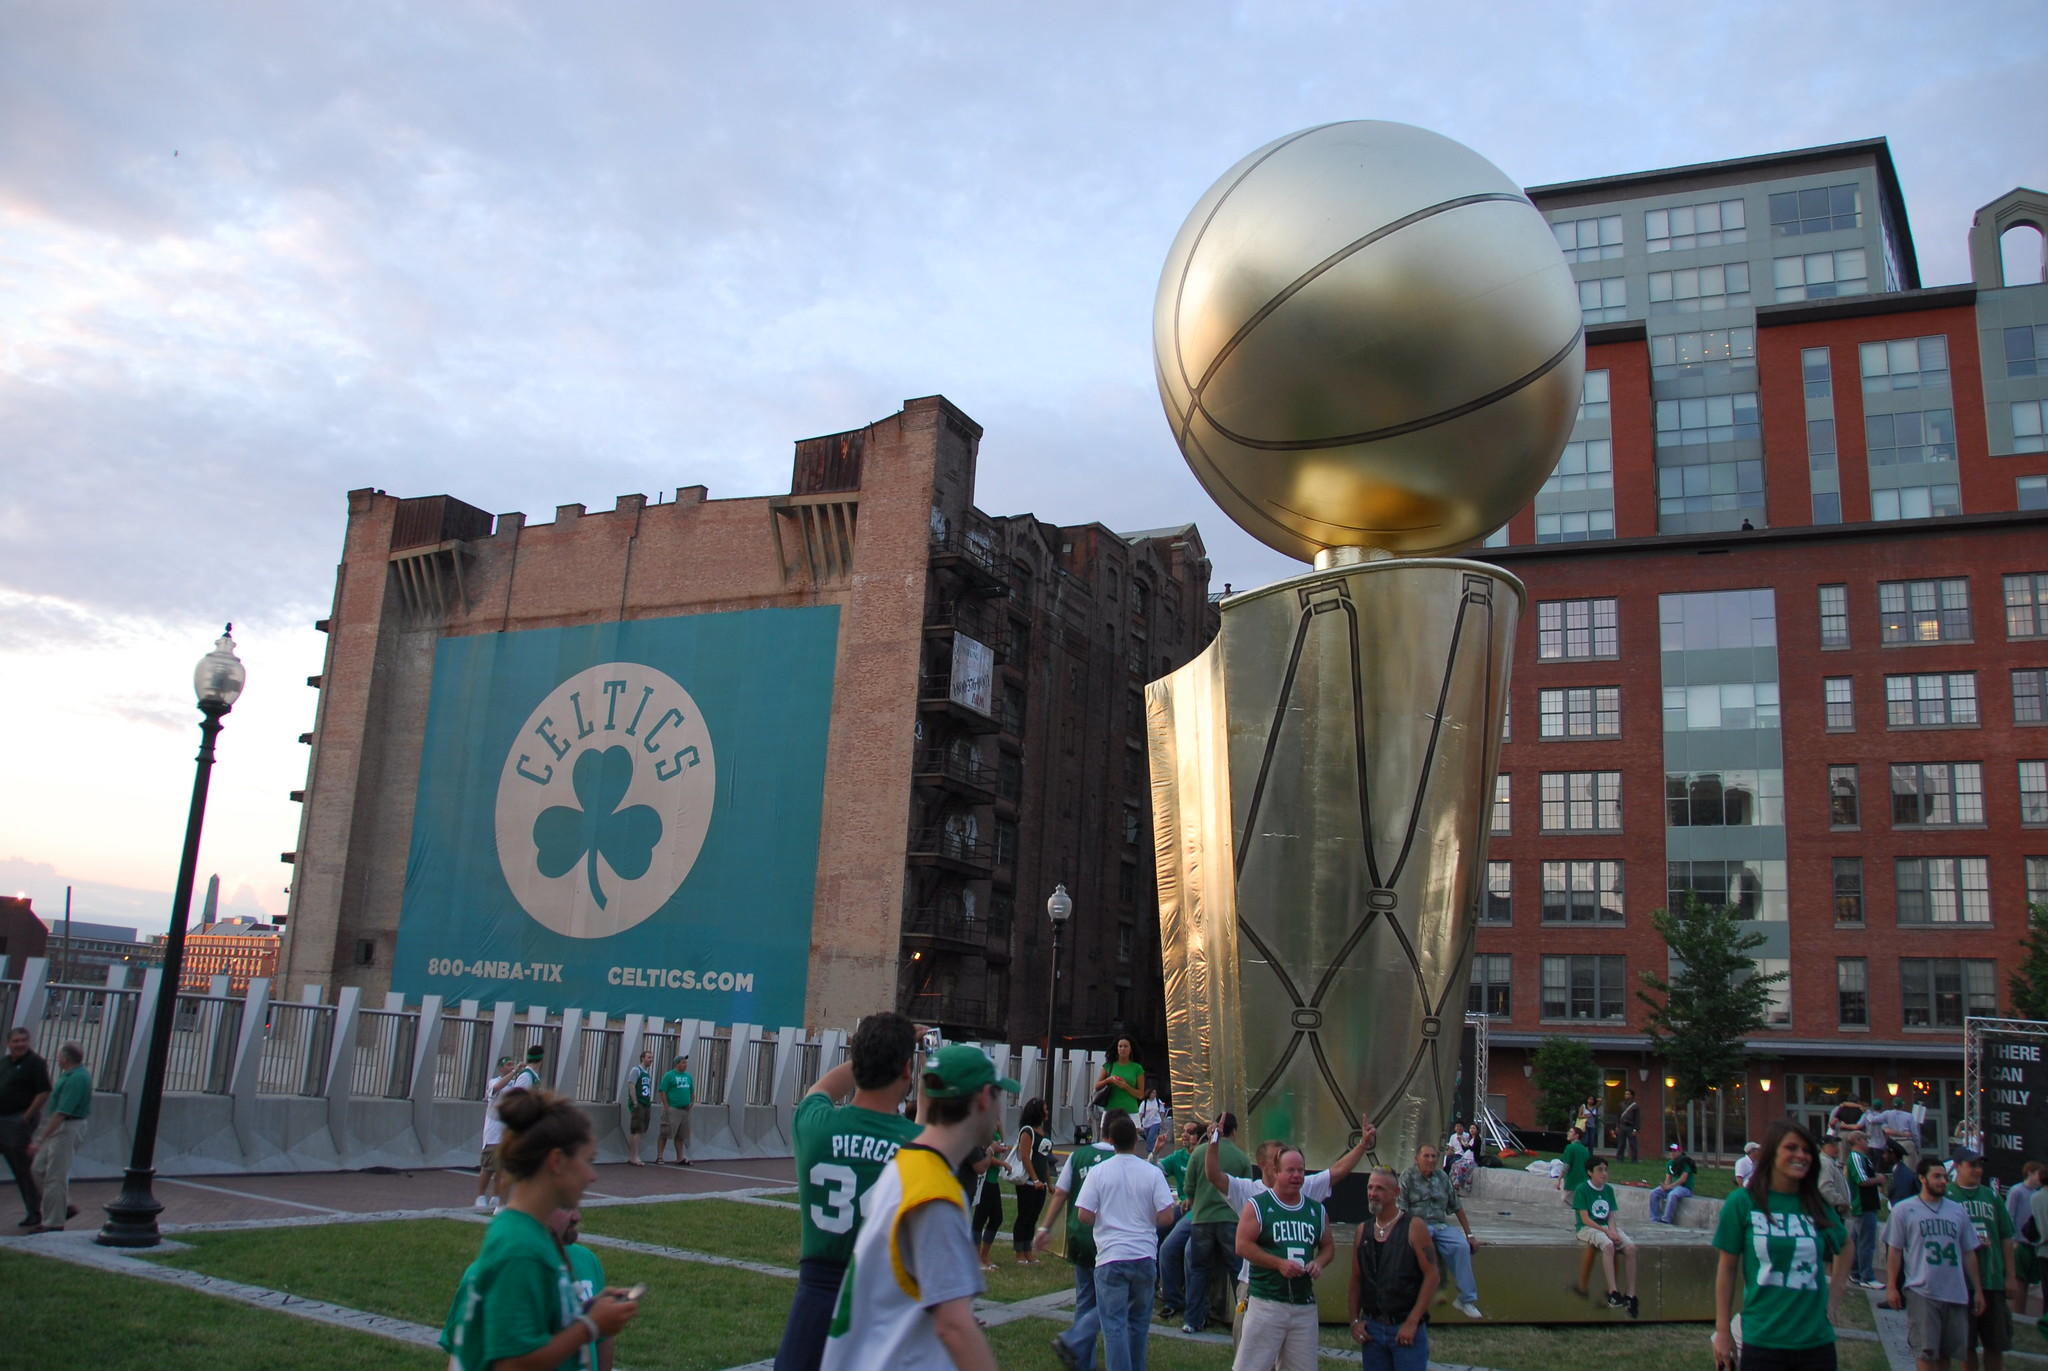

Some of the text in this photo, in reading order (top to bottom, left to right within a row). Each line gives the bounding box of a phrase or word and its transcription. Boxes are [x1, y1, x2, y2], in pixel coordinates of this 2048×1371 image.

[516, 680, 701, 786] CELTICS
[428, 958, 754, 993] 800-4NBA-TIX CELTICS.COM
[1990, 1044, 2041, 1062] THERE
[1990, 1066, 2023, 1083] CAN
[1990, 1089, 2030, 1106] ONLY
[1990, 1111, 2011, 1127] BE
[1991, 1134, 2023, 1151] ONE
[810, 1162, 872, 1235] 3
[1961, 1200, 1995, 1221] ELTICS
[1273, 1220, 1315, 1245] CELTICS
[1919, 1219, 1958, 1240] CELTICS
[1287, 1247, 1305, 1269] 5
[1753, 1236, 1818, 1290] LA
[1925, 1241, 1958, 1267] 34
